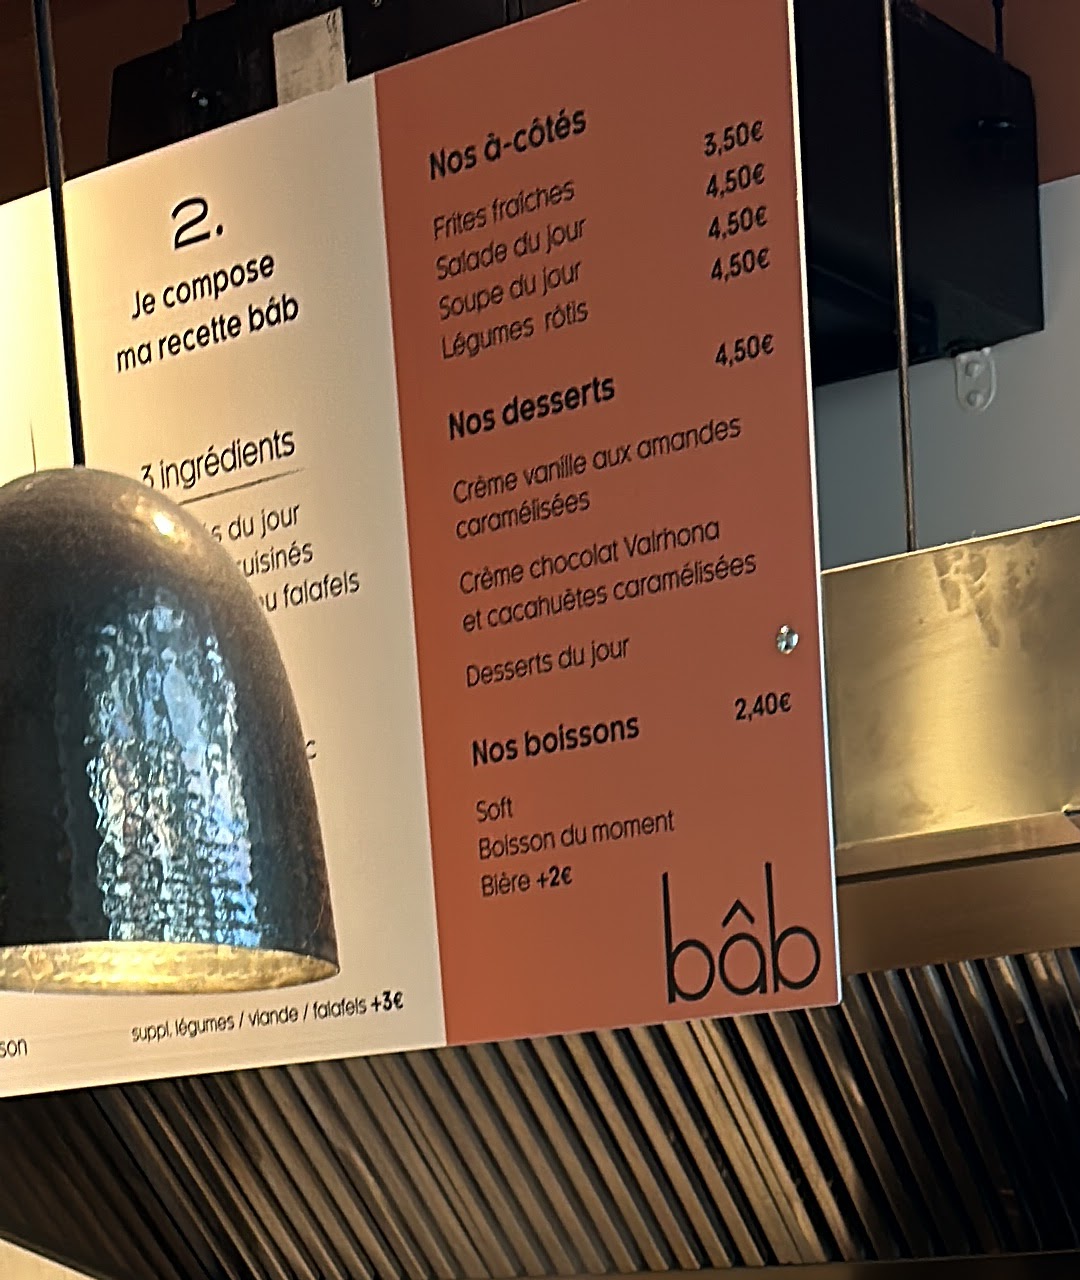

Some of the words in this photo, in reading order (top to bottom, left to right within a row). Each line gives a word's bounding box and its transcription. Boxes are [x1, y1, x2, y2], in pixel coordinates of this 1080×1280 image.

[429, 144, 477, 180] Nos
[704, 120, 763, 156] 3,50€
[706, 163, 765, 198] 4,50€
[171, 197, 223, 250] 2.
[433, 205, 486, 241] Frites
[708, 205, 768, 240] 4,50€
[436, 241, 507, 280] Salade
[513, 230, 540, 256] du
[546, 218, 586, 254] jour
[711, 247, 770, 282] 4,50€
[132, 290, 155, 320] Je
[163, 254, 274, 309] compose
[438, 283, 504, 320] Soupe
[510, 273, 536, 299] du
[542, 261, 582, 296] jour
[117, 341, 151, 373] ma
[159, 314, 241, 360] recette
[441, 316, 534, 360] Légumes
[715, 333, 774, 367] 4,50€
[448, 408, 495, 440] Nos
[502, 377, 615, 426] desserts
[160, 430, 295, 491] ingrédients
[453, 469, 517, 503] Crème
[523, 454, 587, 487] vanille
[592, 444, 631, 471] aux
[637, 417, 741, 461] amandes
[229, 514, 254, 541] du
[260, 504, 300, 539] jour
[456, 490, 590, 539] caramélisées
[460, 561, 524, 595] Crème
[529, 540, 619, 579] chocolat
[623, 520, 720, 558] Valrhona
[283, 569, 360, 608] falafels
[462, 611, 482, 633] et
[613, 553, 756, 600] caramélisées
[466, 652, 553, 688] Desserts
[558, 645, 584, 669] du
[590, 637, 630, 669] jour
[735, 692, 792, 721] 2,40€
[472, 738, 518, 767] Nos
[524, 716, 640, 756] boissons
[476, 796, 513, 823] Soft
[479, 831, 555, 860] Boisson
[560, 824, 586, 847] du
[592, 810, 674, 843] moment
[481, 871, 530, 897] Bière
[536, 865, 572, 888] +2€
[662, 862, 821, 1003] bâb
[175, 1015, 235, 1038] légumes
[248, 1005, 298, 1027] viande
[313, 997, 367, 1019] falafels
[370, 990, 403, 1012] +3€
